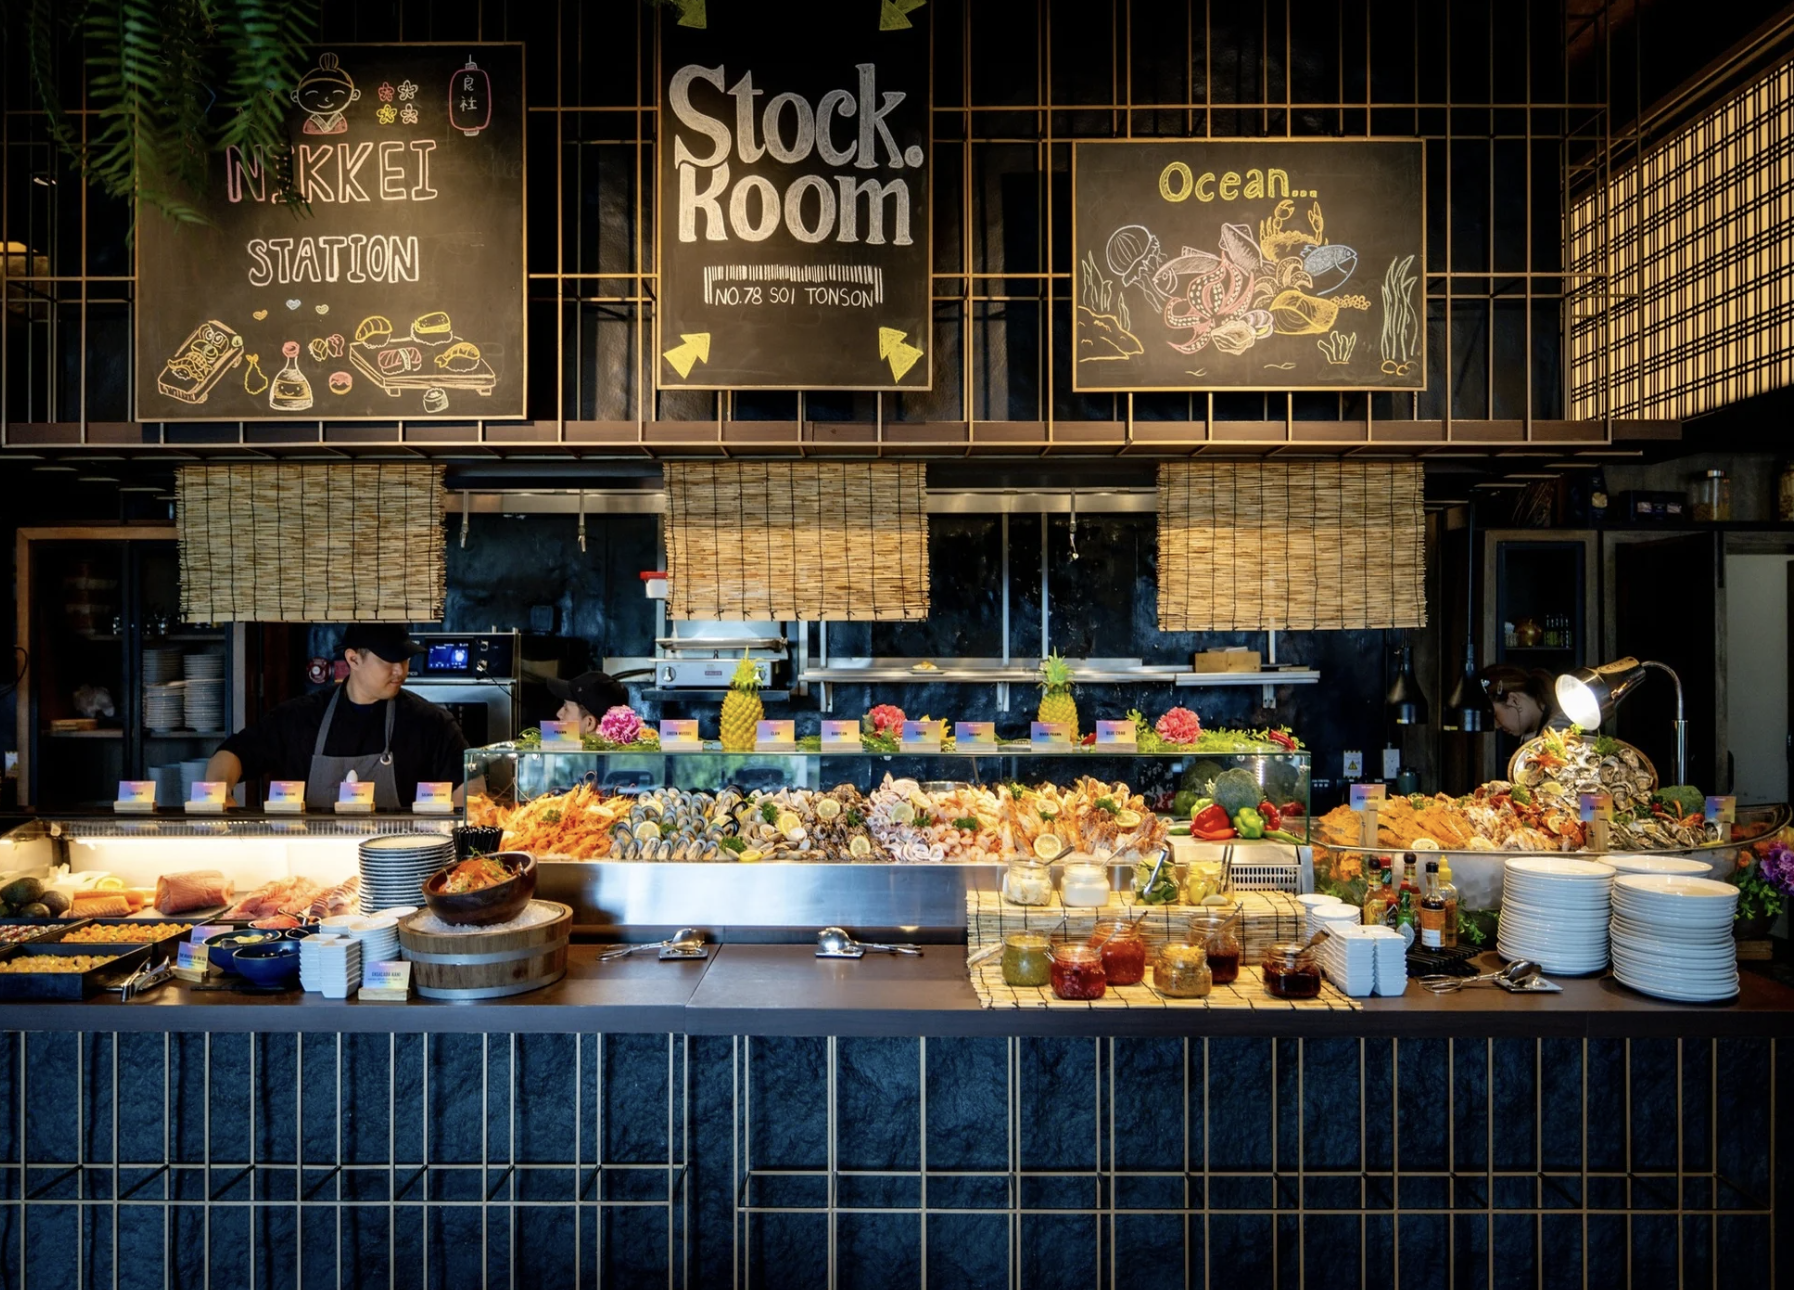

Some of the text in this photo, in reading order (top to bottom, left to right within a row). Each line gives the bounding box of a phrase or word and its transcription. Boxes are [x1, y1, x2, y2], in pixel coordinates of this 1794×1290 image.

[669, 63, 924, 169] Stock.
[678, 161, 914, 245] Room
[247, 234, 420, 287] STATION
[769, 286, 796, 305] SOI
[804, 287, 874, 308] TONSON
